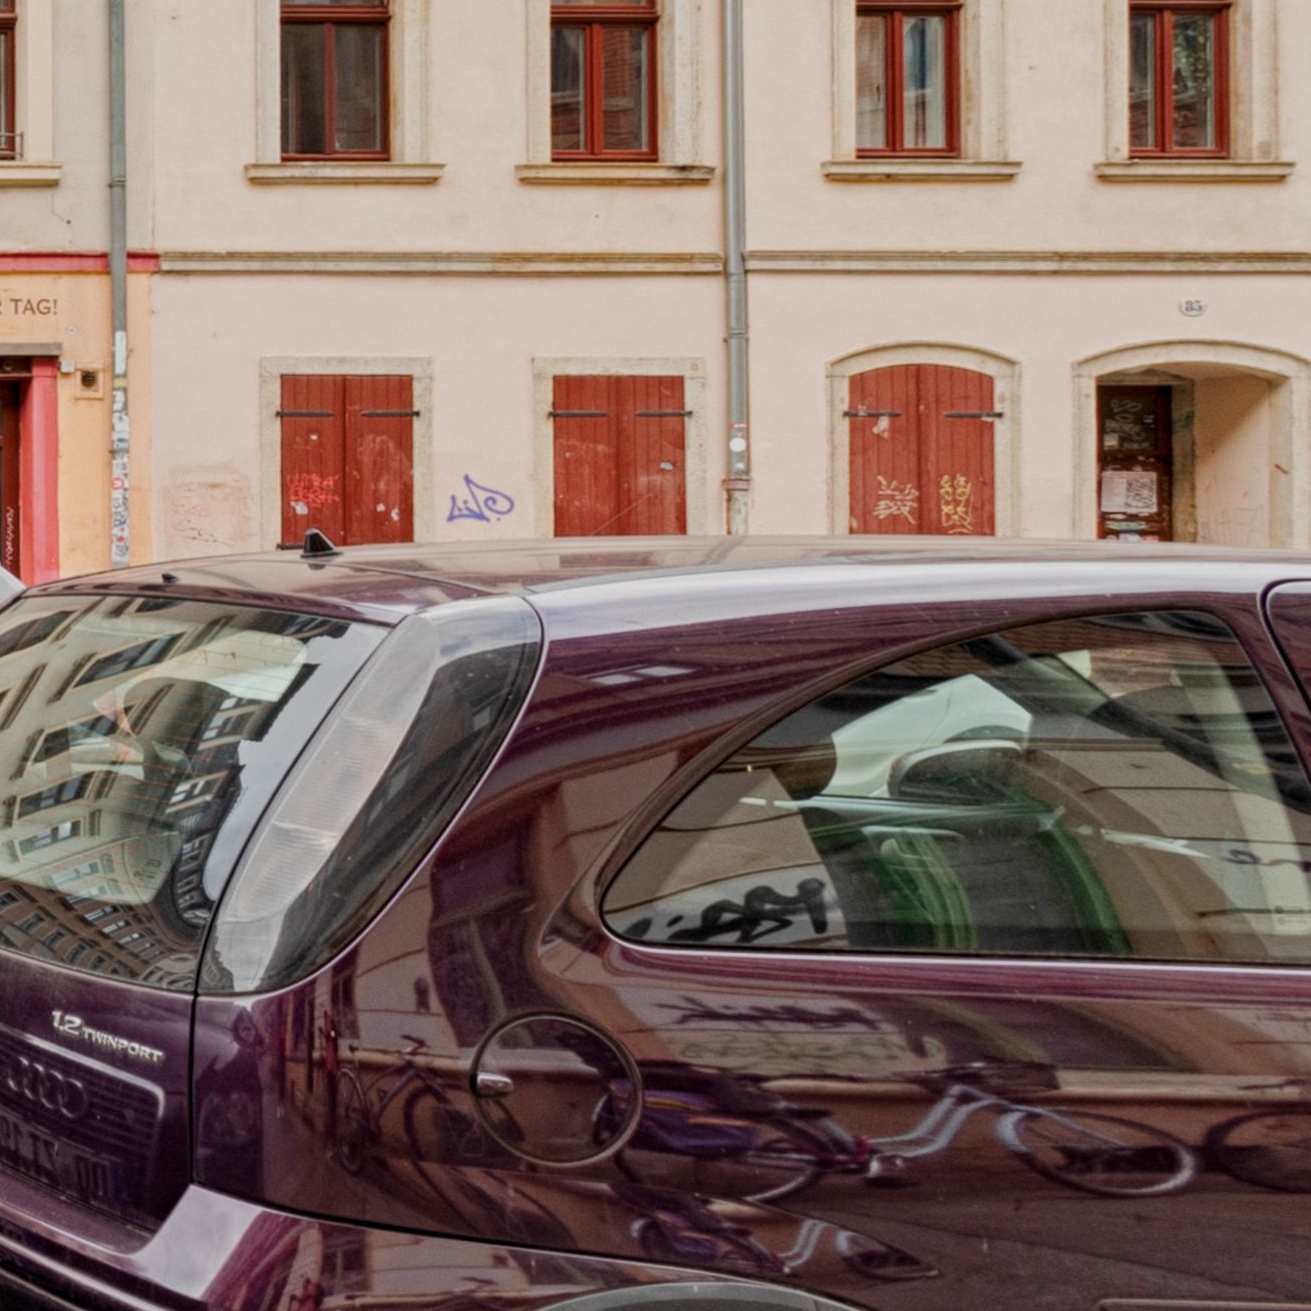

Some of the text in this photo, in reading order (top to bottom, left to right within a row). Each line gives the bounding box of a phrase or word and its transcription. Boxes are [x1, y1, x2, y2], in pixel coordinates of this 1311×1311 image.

[10, 298, 58, 315] TAG!
[52, 1010, 164, 1063] 1.2 TWINPORT
